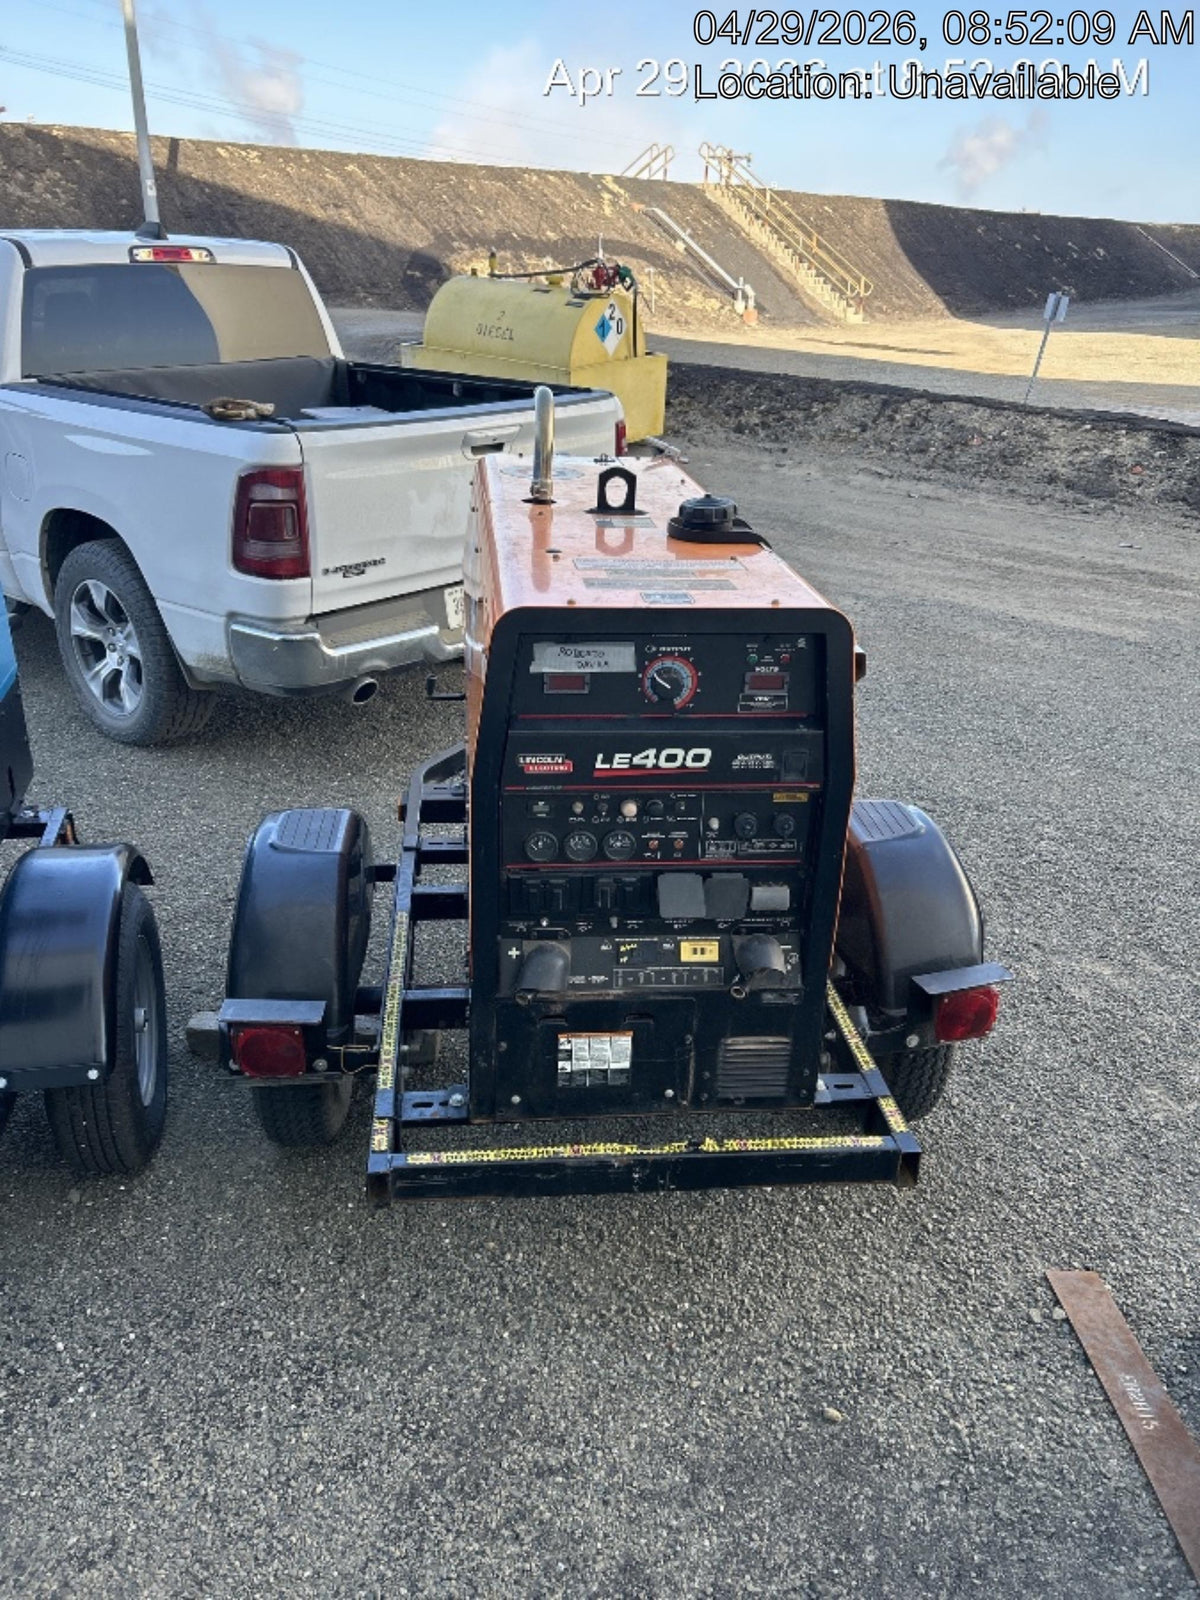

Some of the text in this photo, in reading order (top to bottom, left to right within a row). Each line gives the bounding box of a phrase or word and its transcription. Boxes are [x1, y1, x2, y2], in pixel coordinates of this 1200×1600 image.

[608, 303, 616, 321] 2
[616, 317, 623, 335] 0
[519, 756, 563, 764] LINCOLN
[595, 748, 712, 769] LE400
